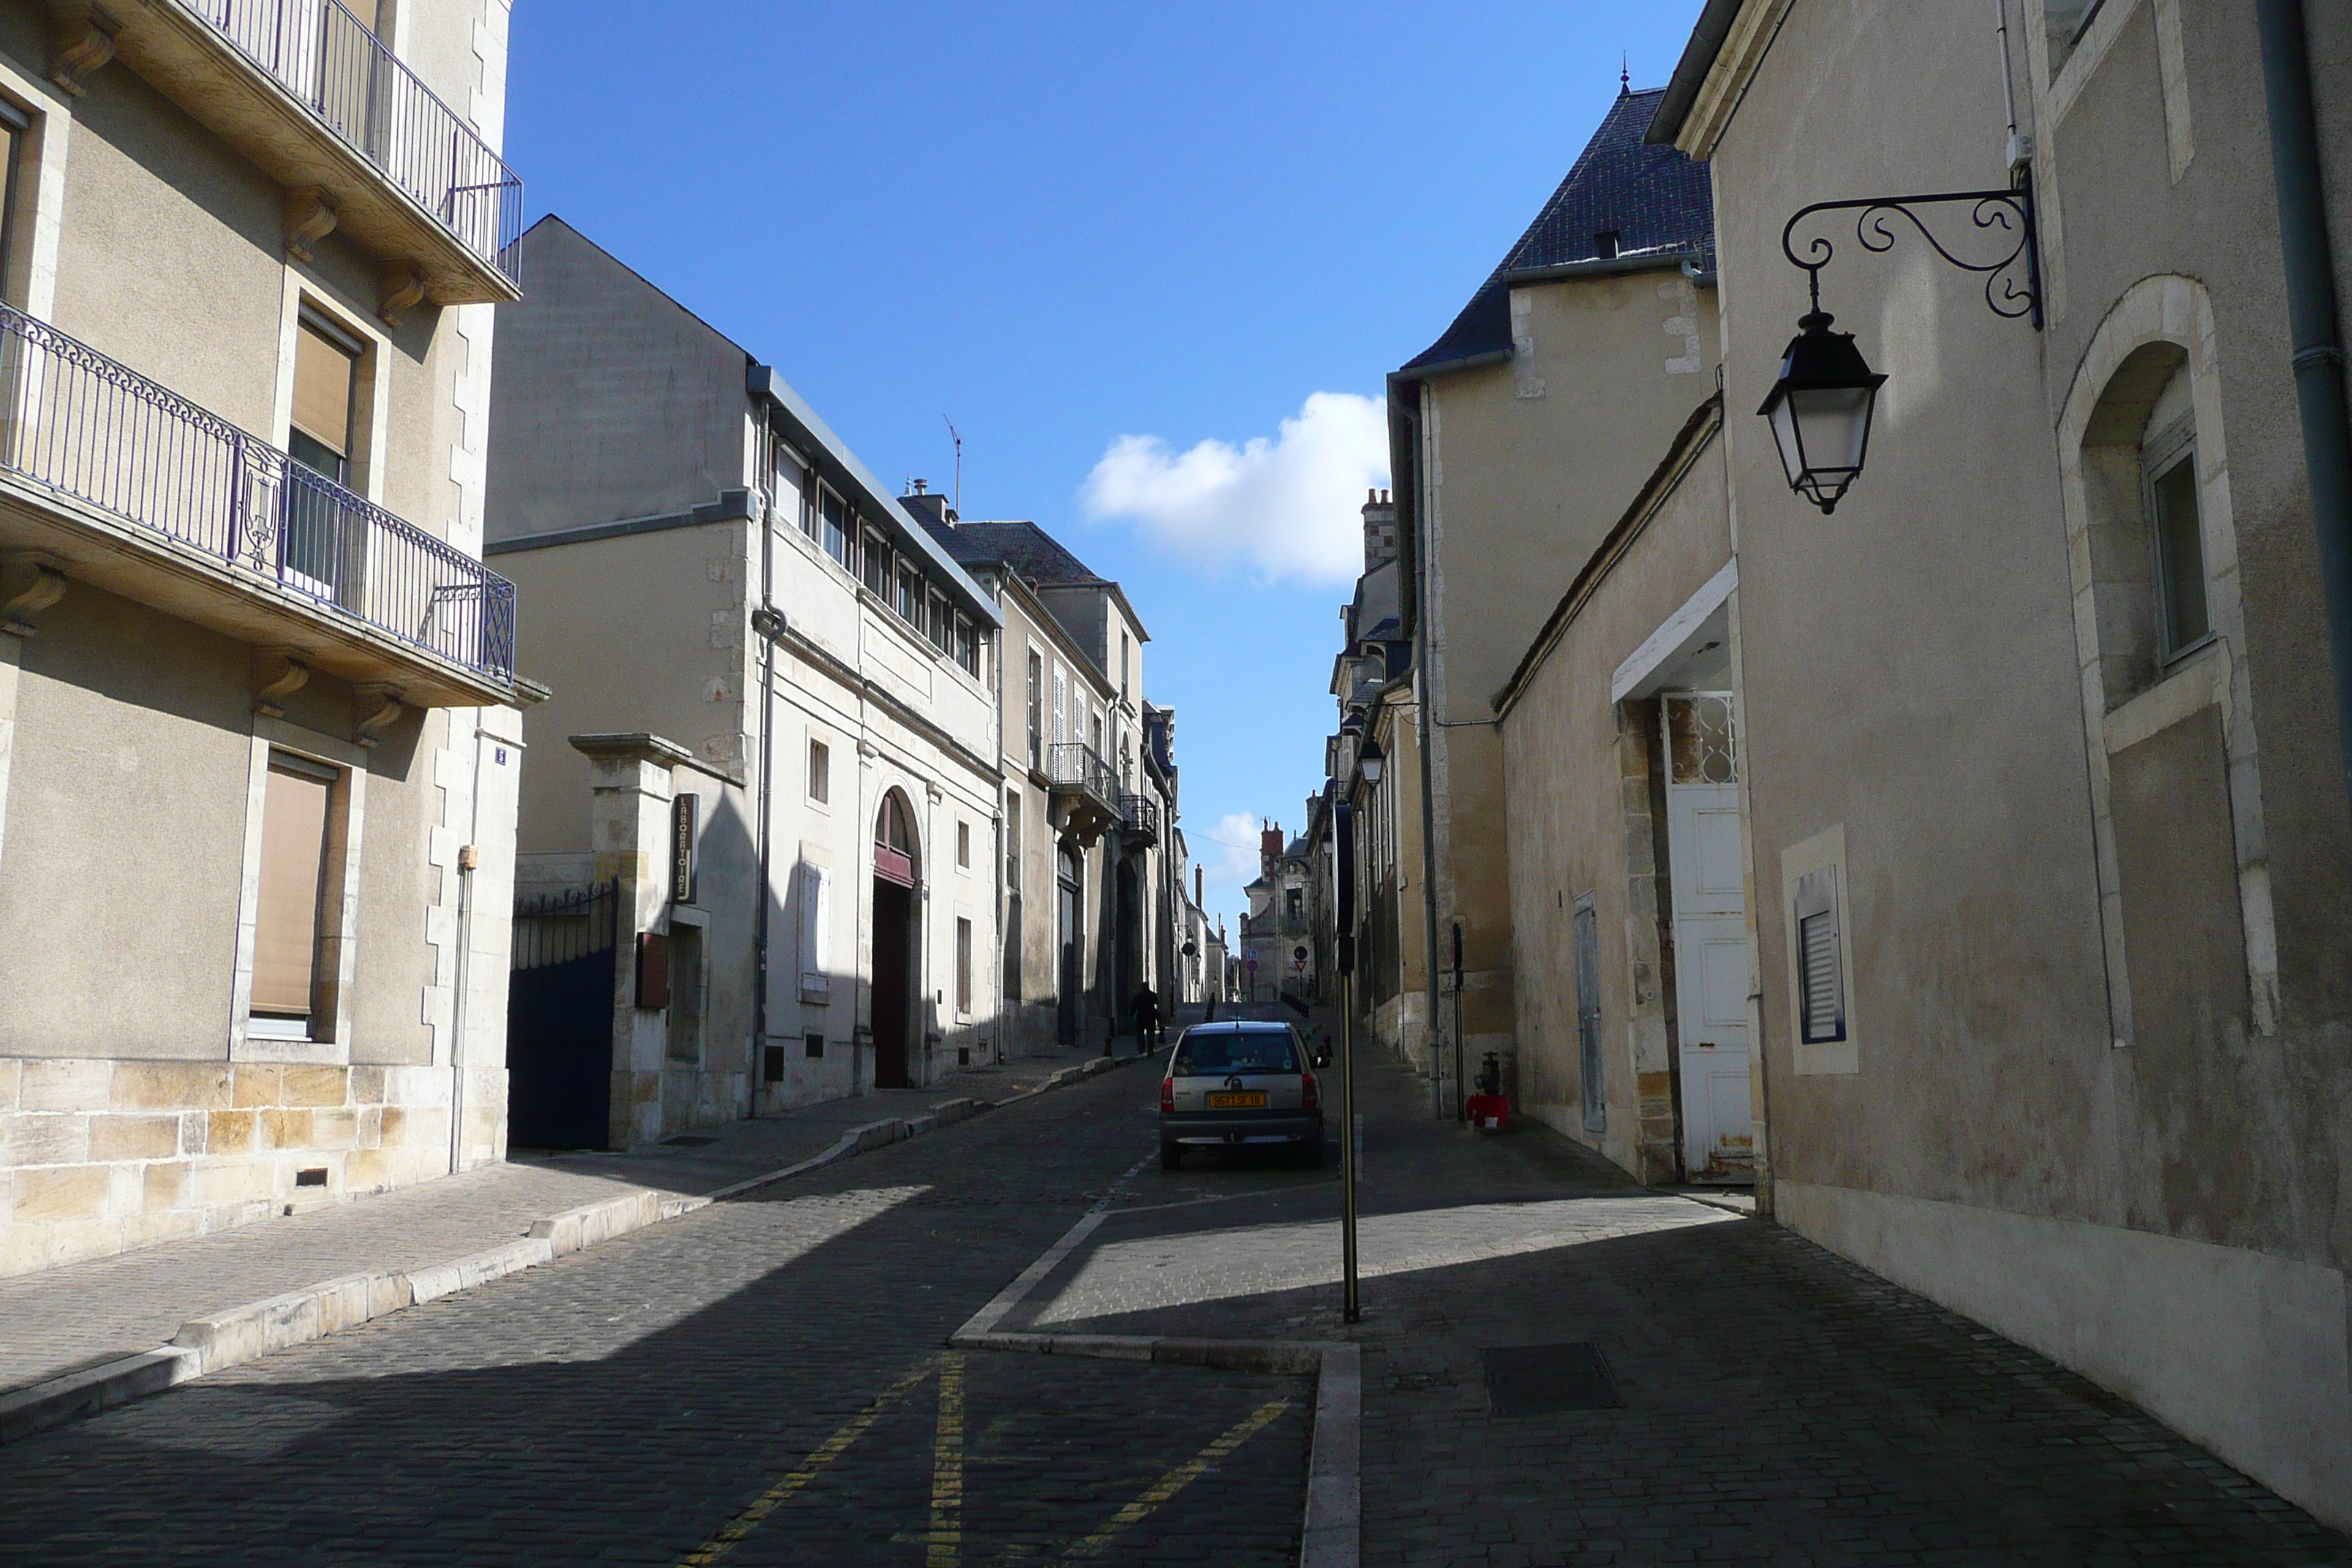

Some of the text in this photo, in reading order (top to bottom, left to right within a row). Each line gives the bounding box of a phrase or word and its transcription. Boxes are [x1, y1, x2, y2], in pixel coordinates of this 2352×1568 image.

[499, 750, 504, 762] 5
[678, 797, 687, 893] LABORATOIRE
[1214, 1096, 1235, 1105] 9671
[1237, 1096, 1248, 1104] SF
